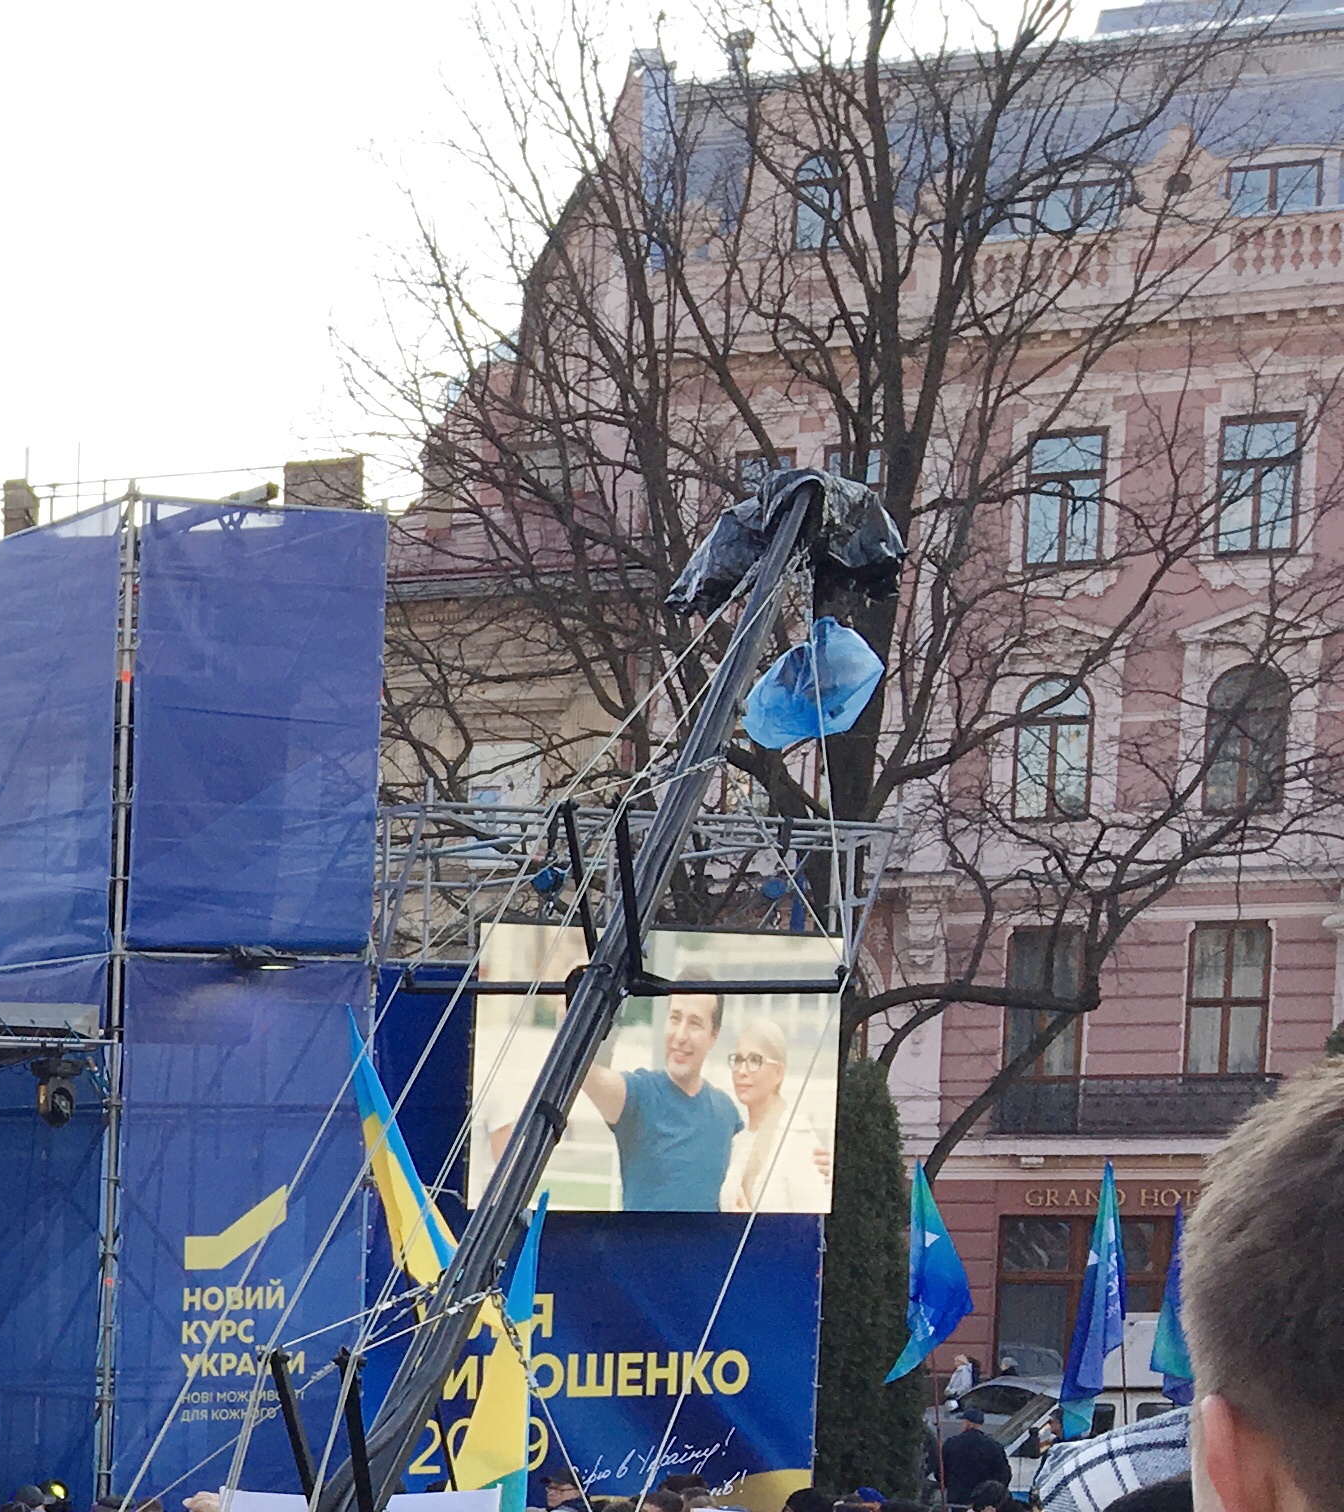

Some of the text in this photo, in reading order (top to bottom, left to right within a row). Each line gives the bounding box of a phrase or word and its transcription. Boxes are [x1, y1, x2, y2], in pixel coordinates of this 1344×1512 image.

[1141, 1188, 1199, 1207] HOT
[182, 1278, 285, 1311] НОВИЙ
[181, 1318, 255, 1344] КУРС
[181, 1408, 209, 1422] ДЛЯ
